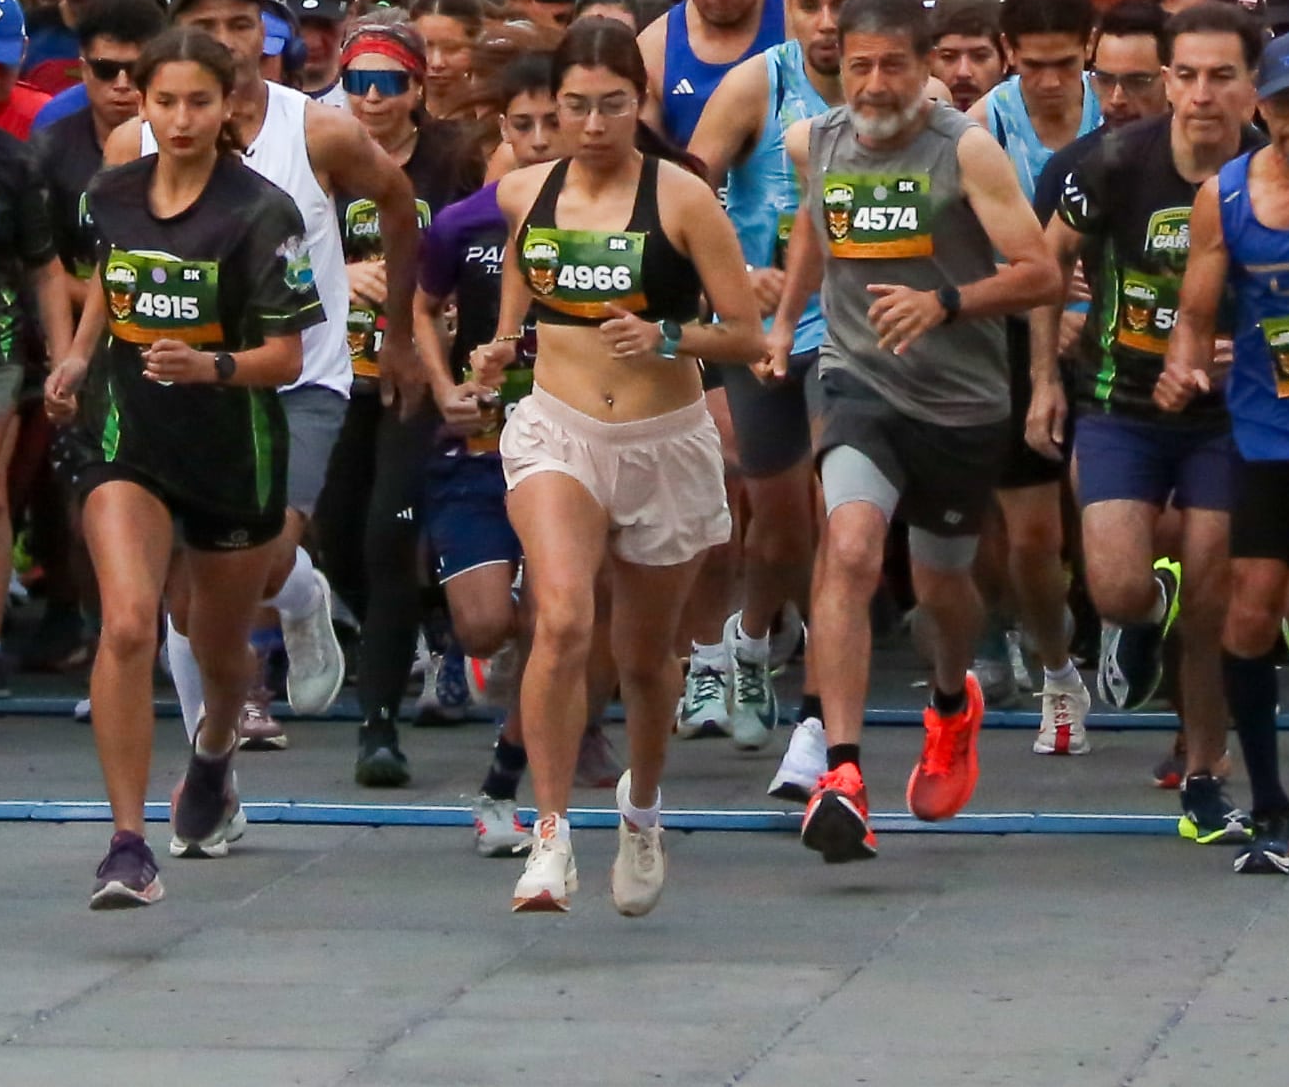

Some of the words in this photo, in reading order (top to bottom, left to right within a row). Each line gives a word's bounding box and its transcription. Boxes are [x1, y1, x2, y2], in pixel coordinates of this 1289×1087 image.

[898, 181, 914, 192] 5K
[853, 207, 918, 230] 4574
[609, 238, 627, 250] 5K
[183, 269, 200, 281] 5K
[558, 265, 631, 290] 4966
[135, 292, 200, 319] 4915
